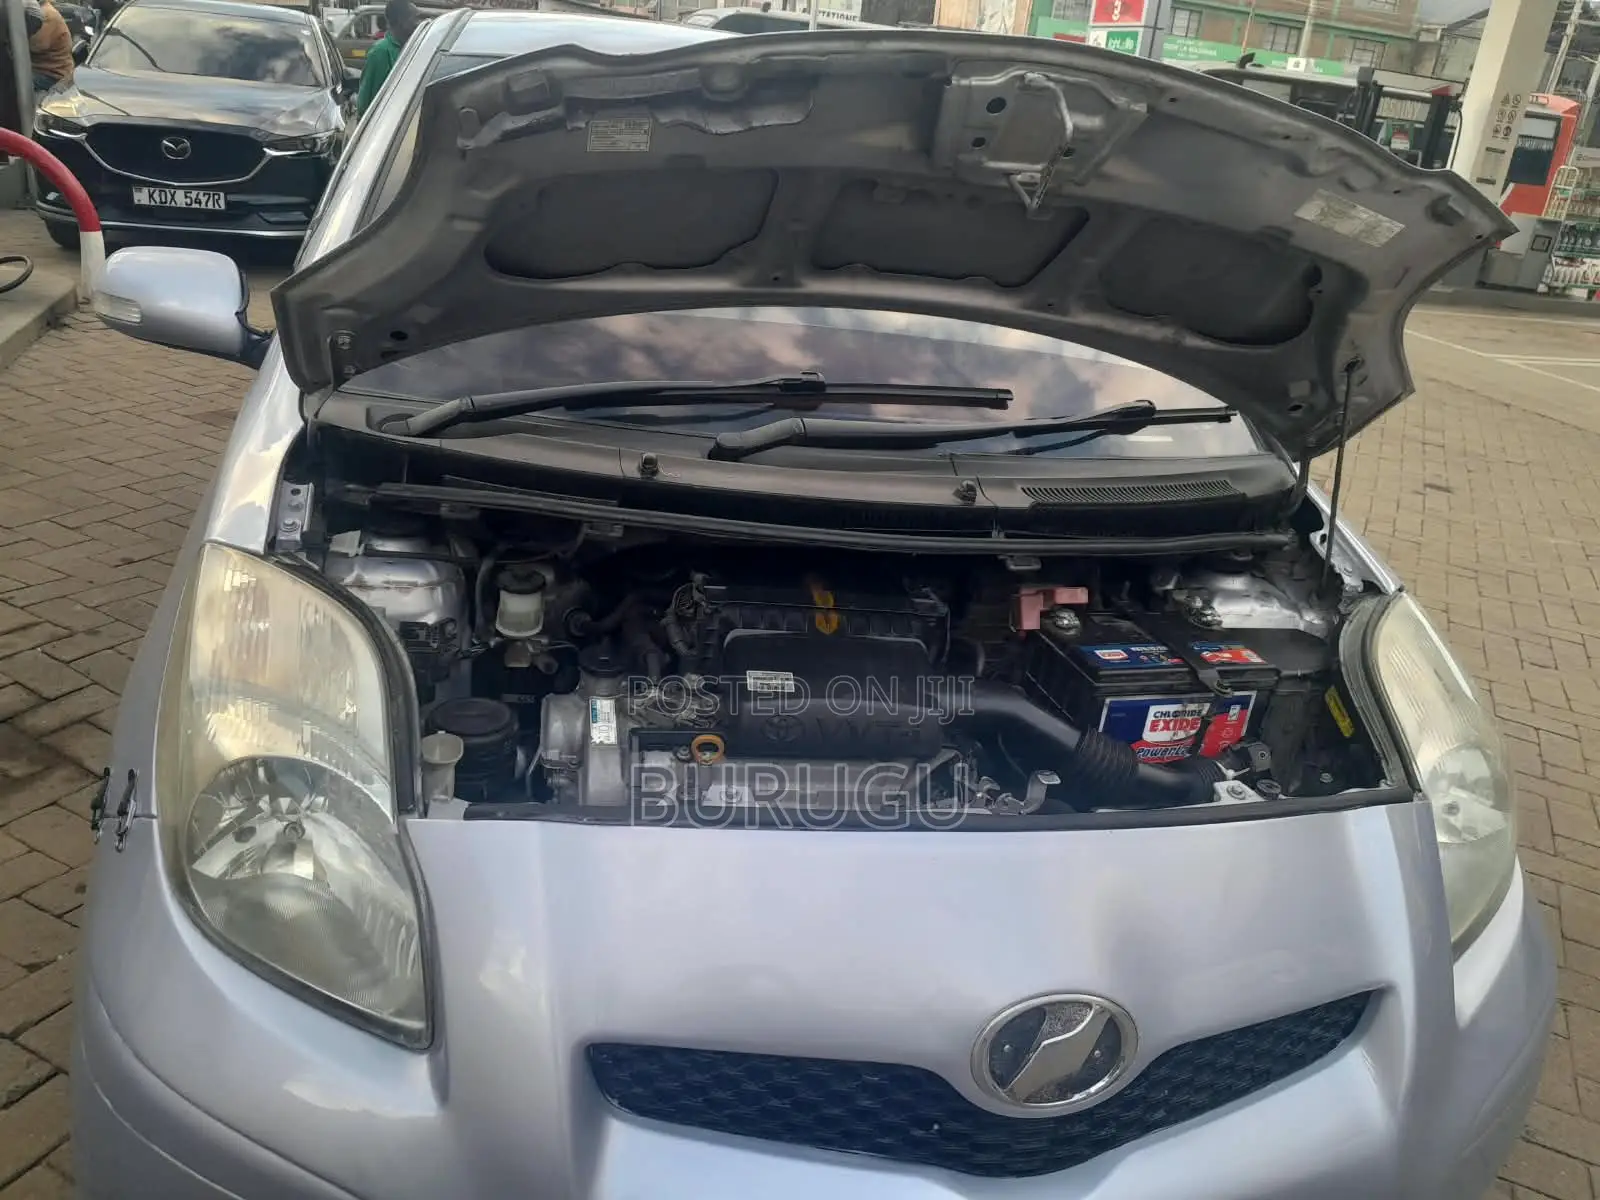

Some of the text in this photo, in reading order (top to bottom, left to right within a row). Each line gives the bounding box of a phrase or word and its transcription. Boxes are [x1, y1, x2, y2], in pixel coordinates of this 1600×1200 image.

[147, 188, 222, 209] KDX 547R
[1153, 709, 1202, 719] CHLORIDE
[1149, 718, 1201, 733] EXIDE
